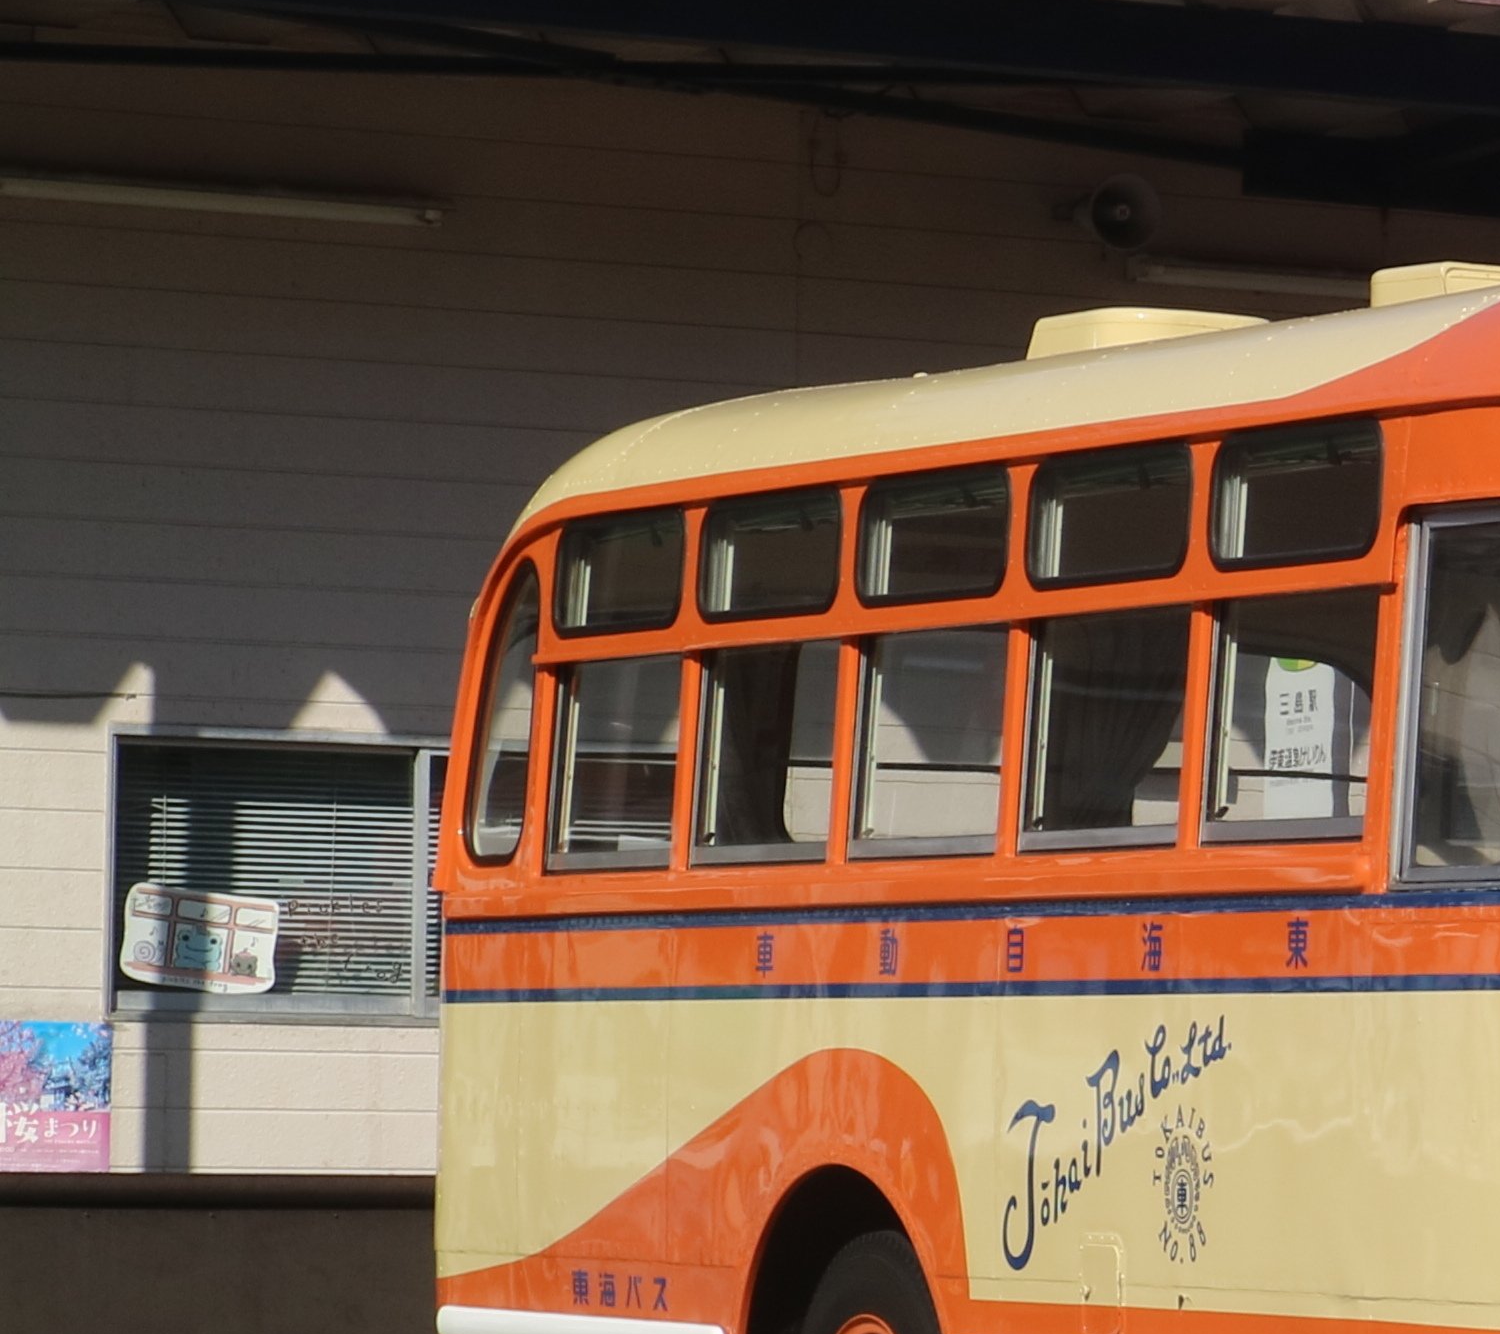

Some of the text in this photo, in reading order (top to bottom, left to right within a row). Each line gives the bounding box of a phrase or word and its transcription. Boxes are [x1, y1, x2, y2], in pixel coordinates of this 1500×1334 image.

[1085, 1049, 1145, 1177] Bus
[571, 1270, 668, 1312] 東海バス
